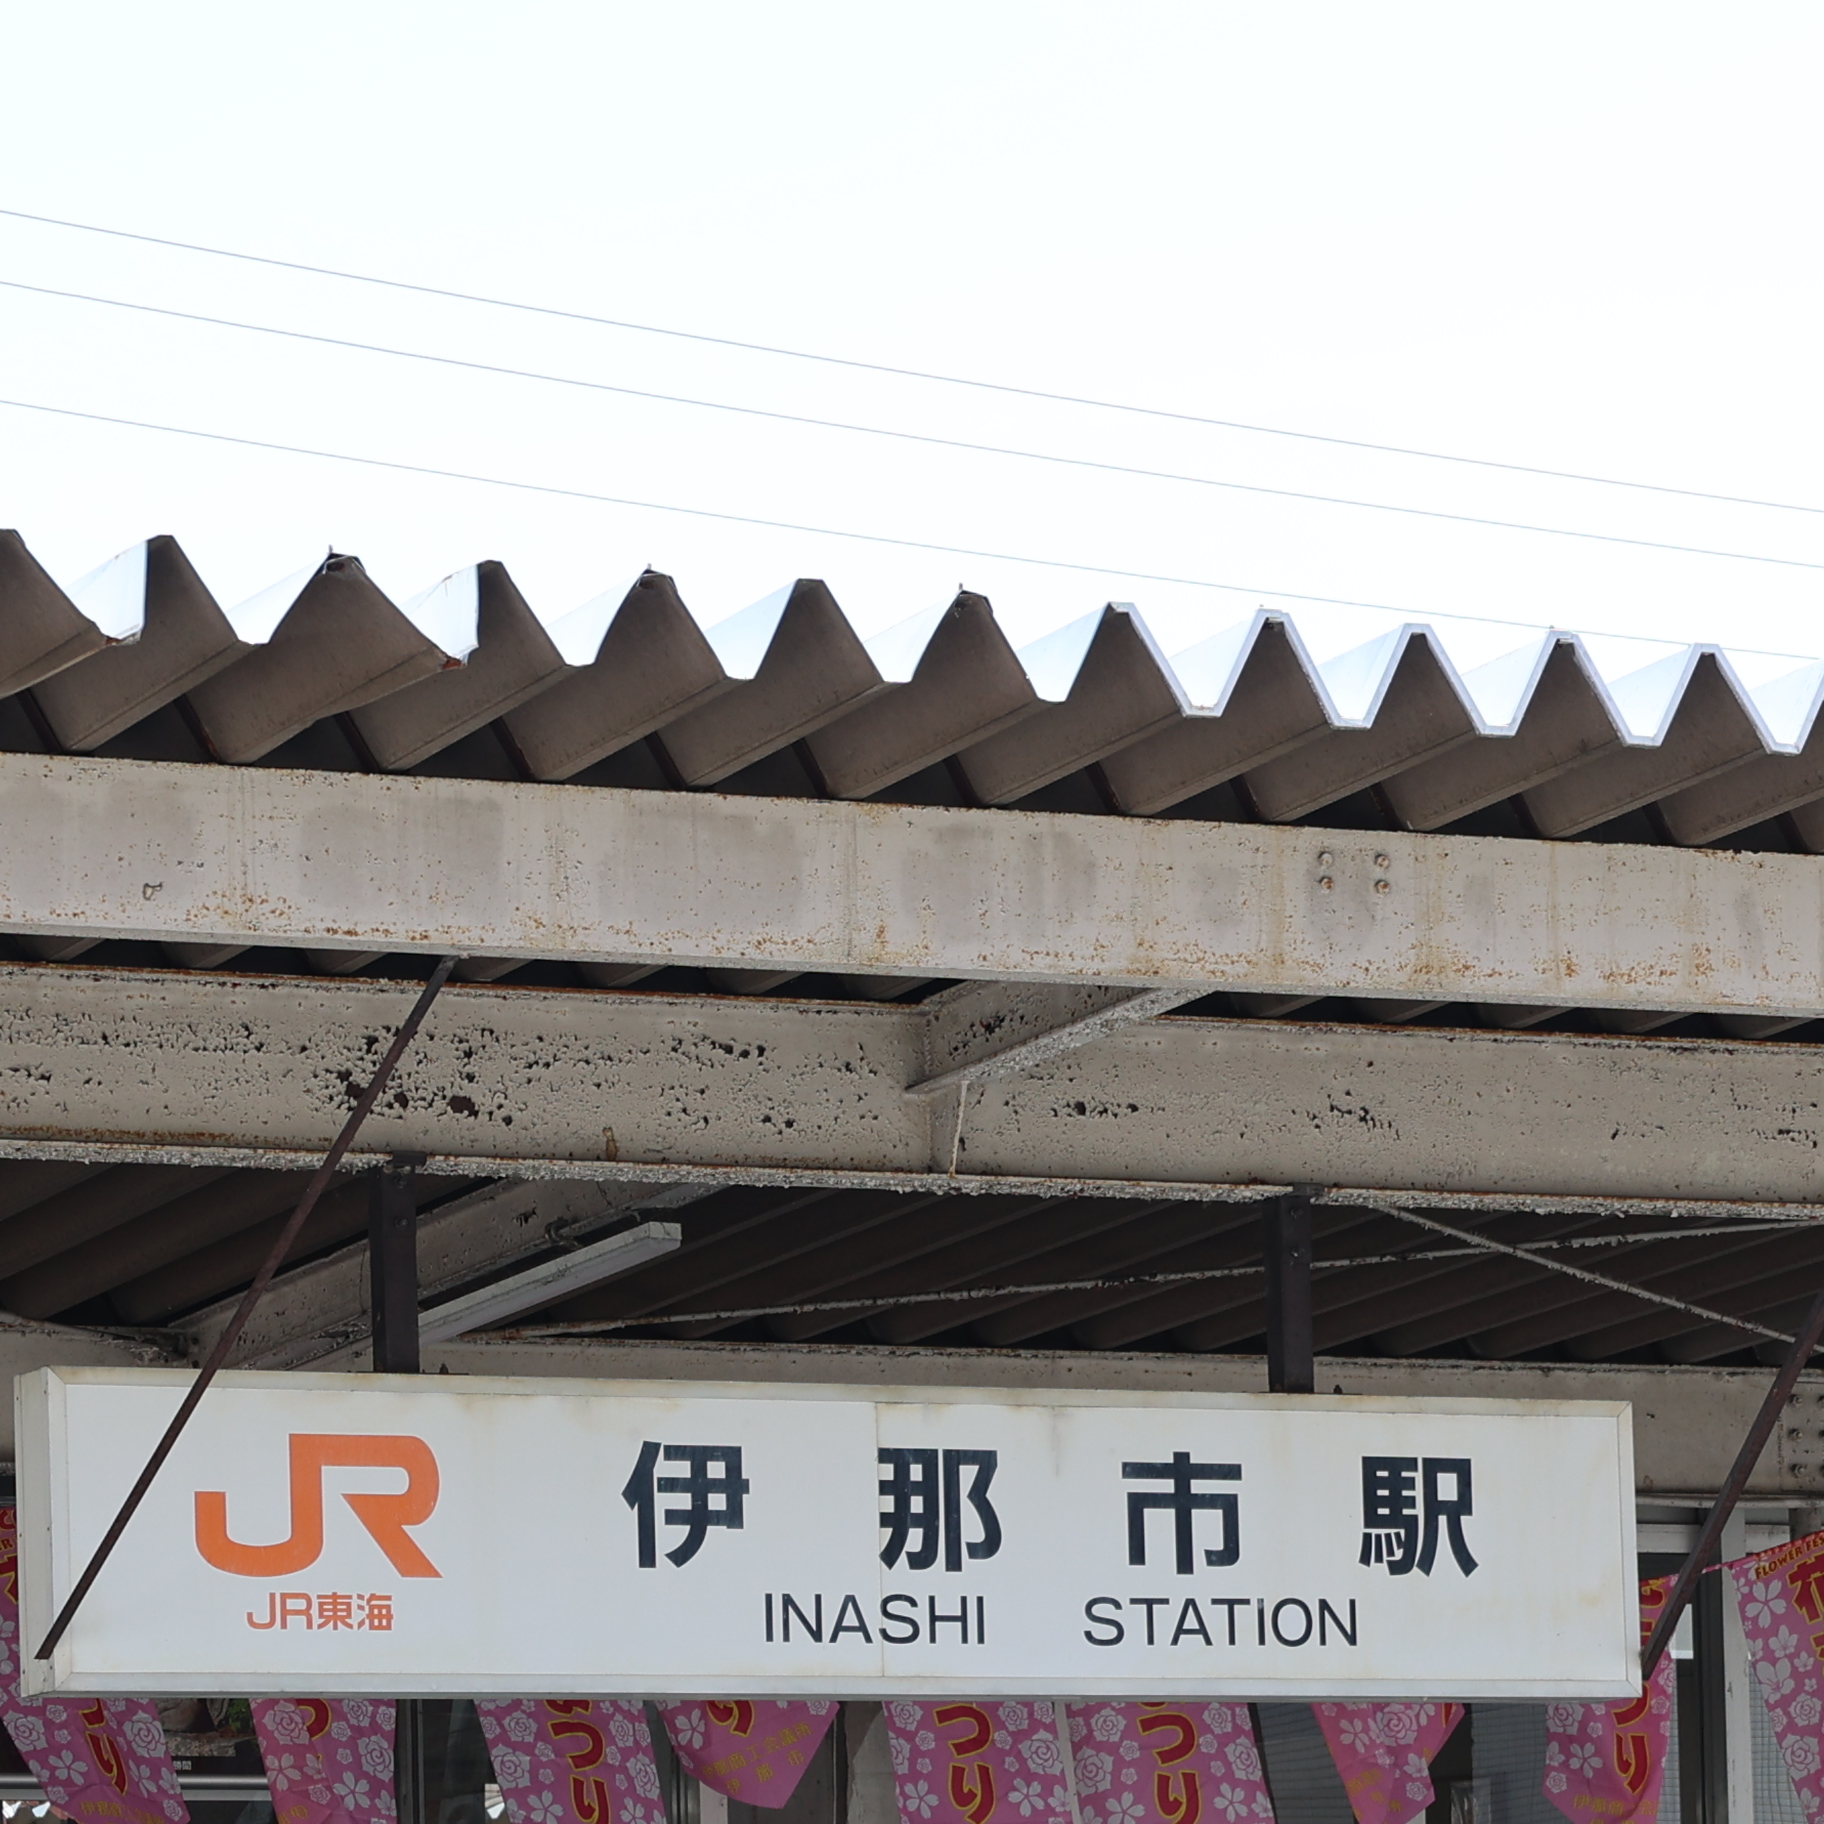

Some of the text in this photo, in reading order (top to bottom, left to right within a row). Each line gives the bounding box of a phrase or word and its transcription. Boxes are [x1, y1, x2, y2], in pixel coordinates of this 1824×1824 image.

[193, 1433, 443, 1578] JR
[621, 1440, 1480, 1578] 伊那市駅
[1754, 1549, 1804, 1581] FLOWER
[246, 1591, 394, 1631] JR東海
[763, 1592, 1358, 1649] INASHI STATION
[726, 1748, 805, 1794] 伊那市
